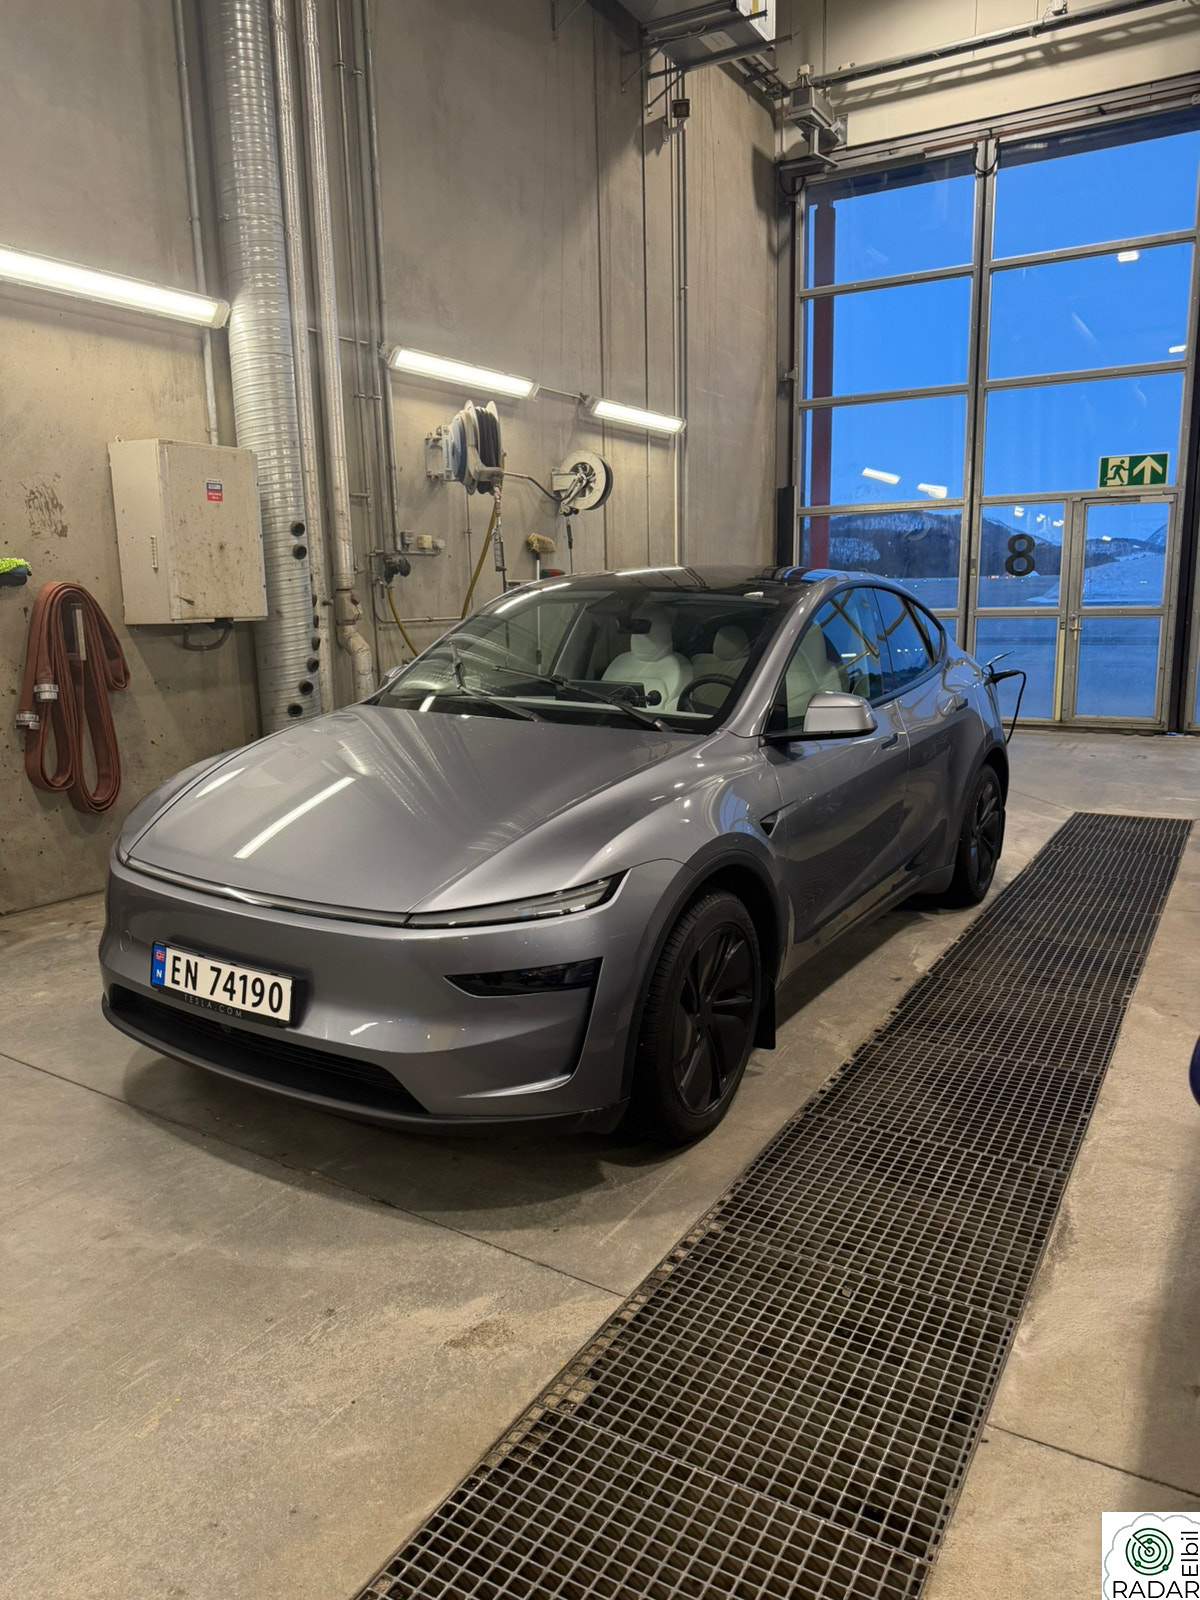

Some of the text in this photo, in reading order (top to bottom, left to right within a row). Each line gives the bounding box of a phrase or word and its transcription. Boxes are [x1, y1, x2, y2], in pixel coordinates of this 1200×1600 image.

[1005, 533, 1036, 577] 8
[155, 968, 163, 979] N
[171, 955, 283, 1013] EN 74190
[184, 993, 243, 1018] TESLA.COM
